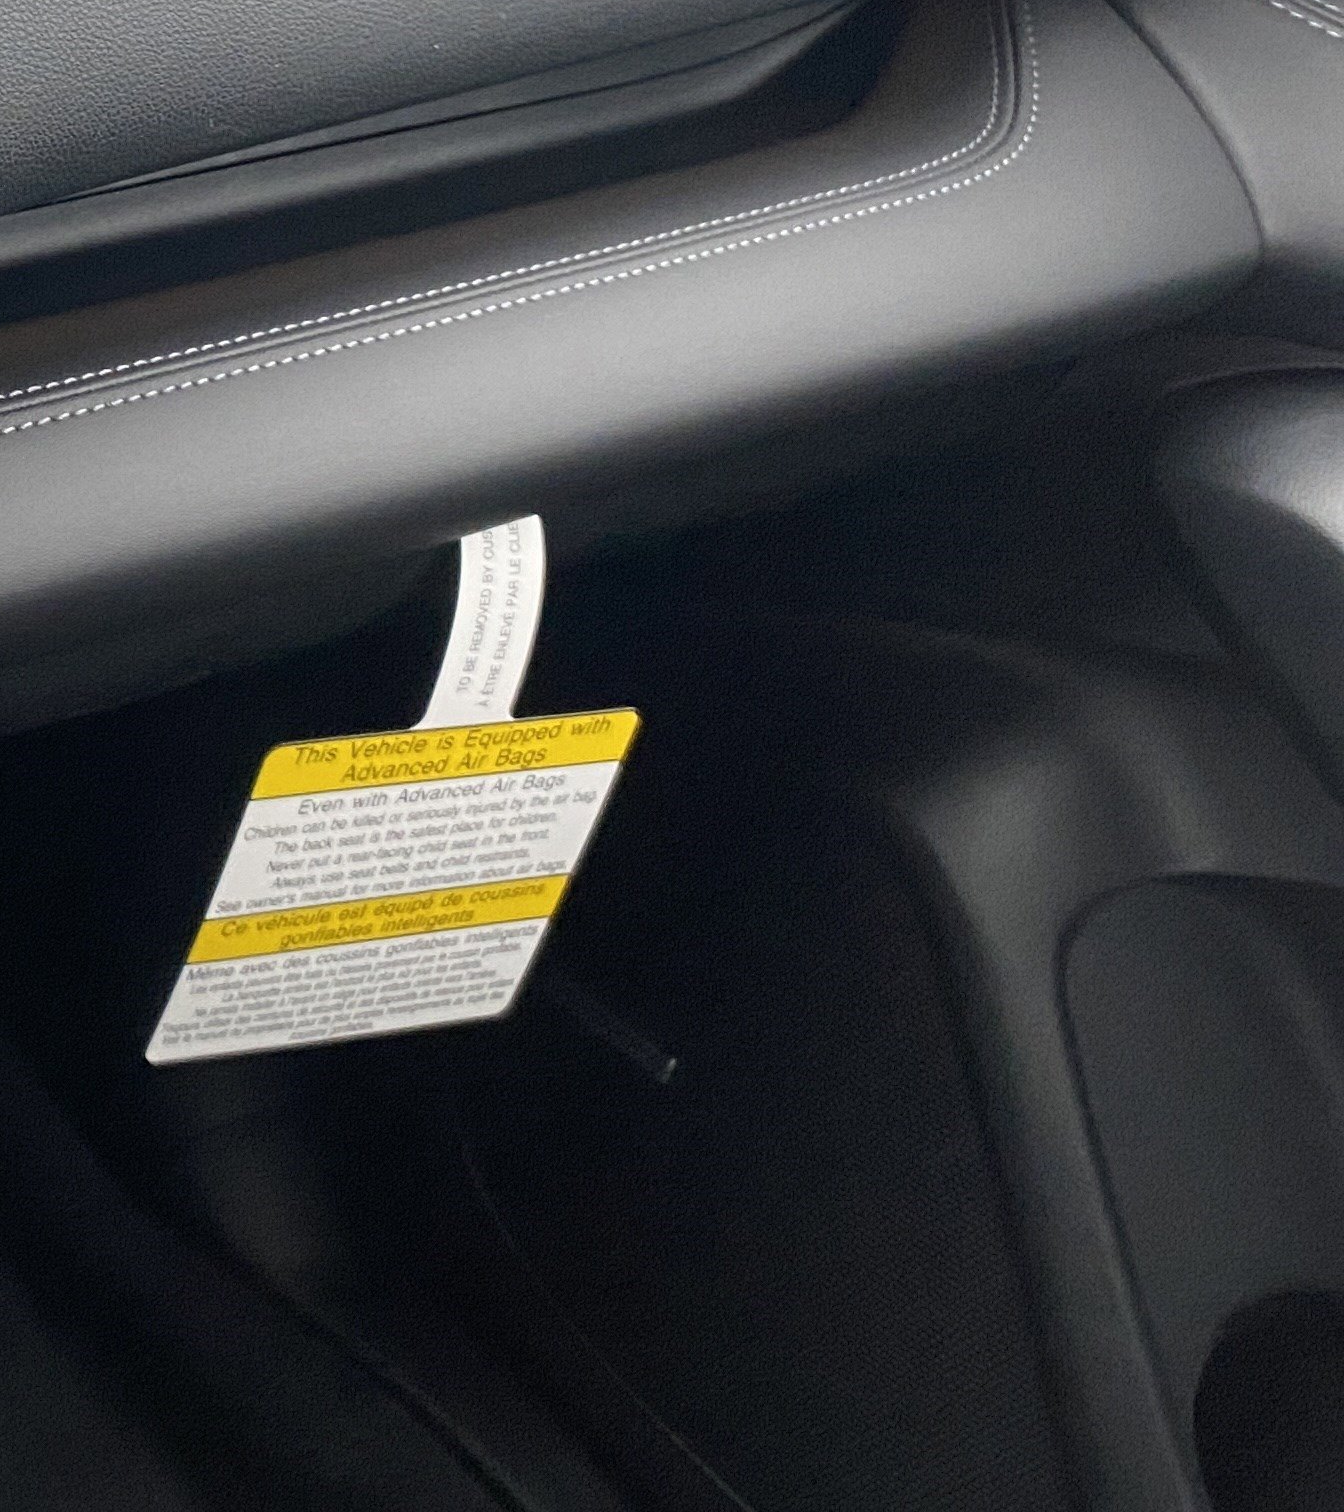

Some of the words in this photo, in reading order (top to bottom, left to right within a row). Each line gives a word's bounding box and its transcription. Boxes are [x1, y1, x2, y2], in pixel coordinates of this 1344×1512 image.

[482, 565, 494, 583] BY
[509, 558, 521, 575] LE
[507, 579, 520, 607] PAR
[469, 589, 491, 653] REMOVED
[463, 657, 478, 671] BE
[296, 747, 336, 764] This
[352, 737, 428, 758] Vehicle
[438, 735, 454, 749] is
[464, 721, 563, 749] Equipped
[571, 716, 613, 735] with
[340, 755, 449, 782] Advanced
[455, 751, 489, 769] Air
[495, 748, 547, 769] Bags
[298, 799, 345, 814] Even
[354, 792, 388, 807] with
[395, 782, 484, 804] Advanced
[492, 778, 517, 791] Air
[523, 775, 567, 791] Bags
